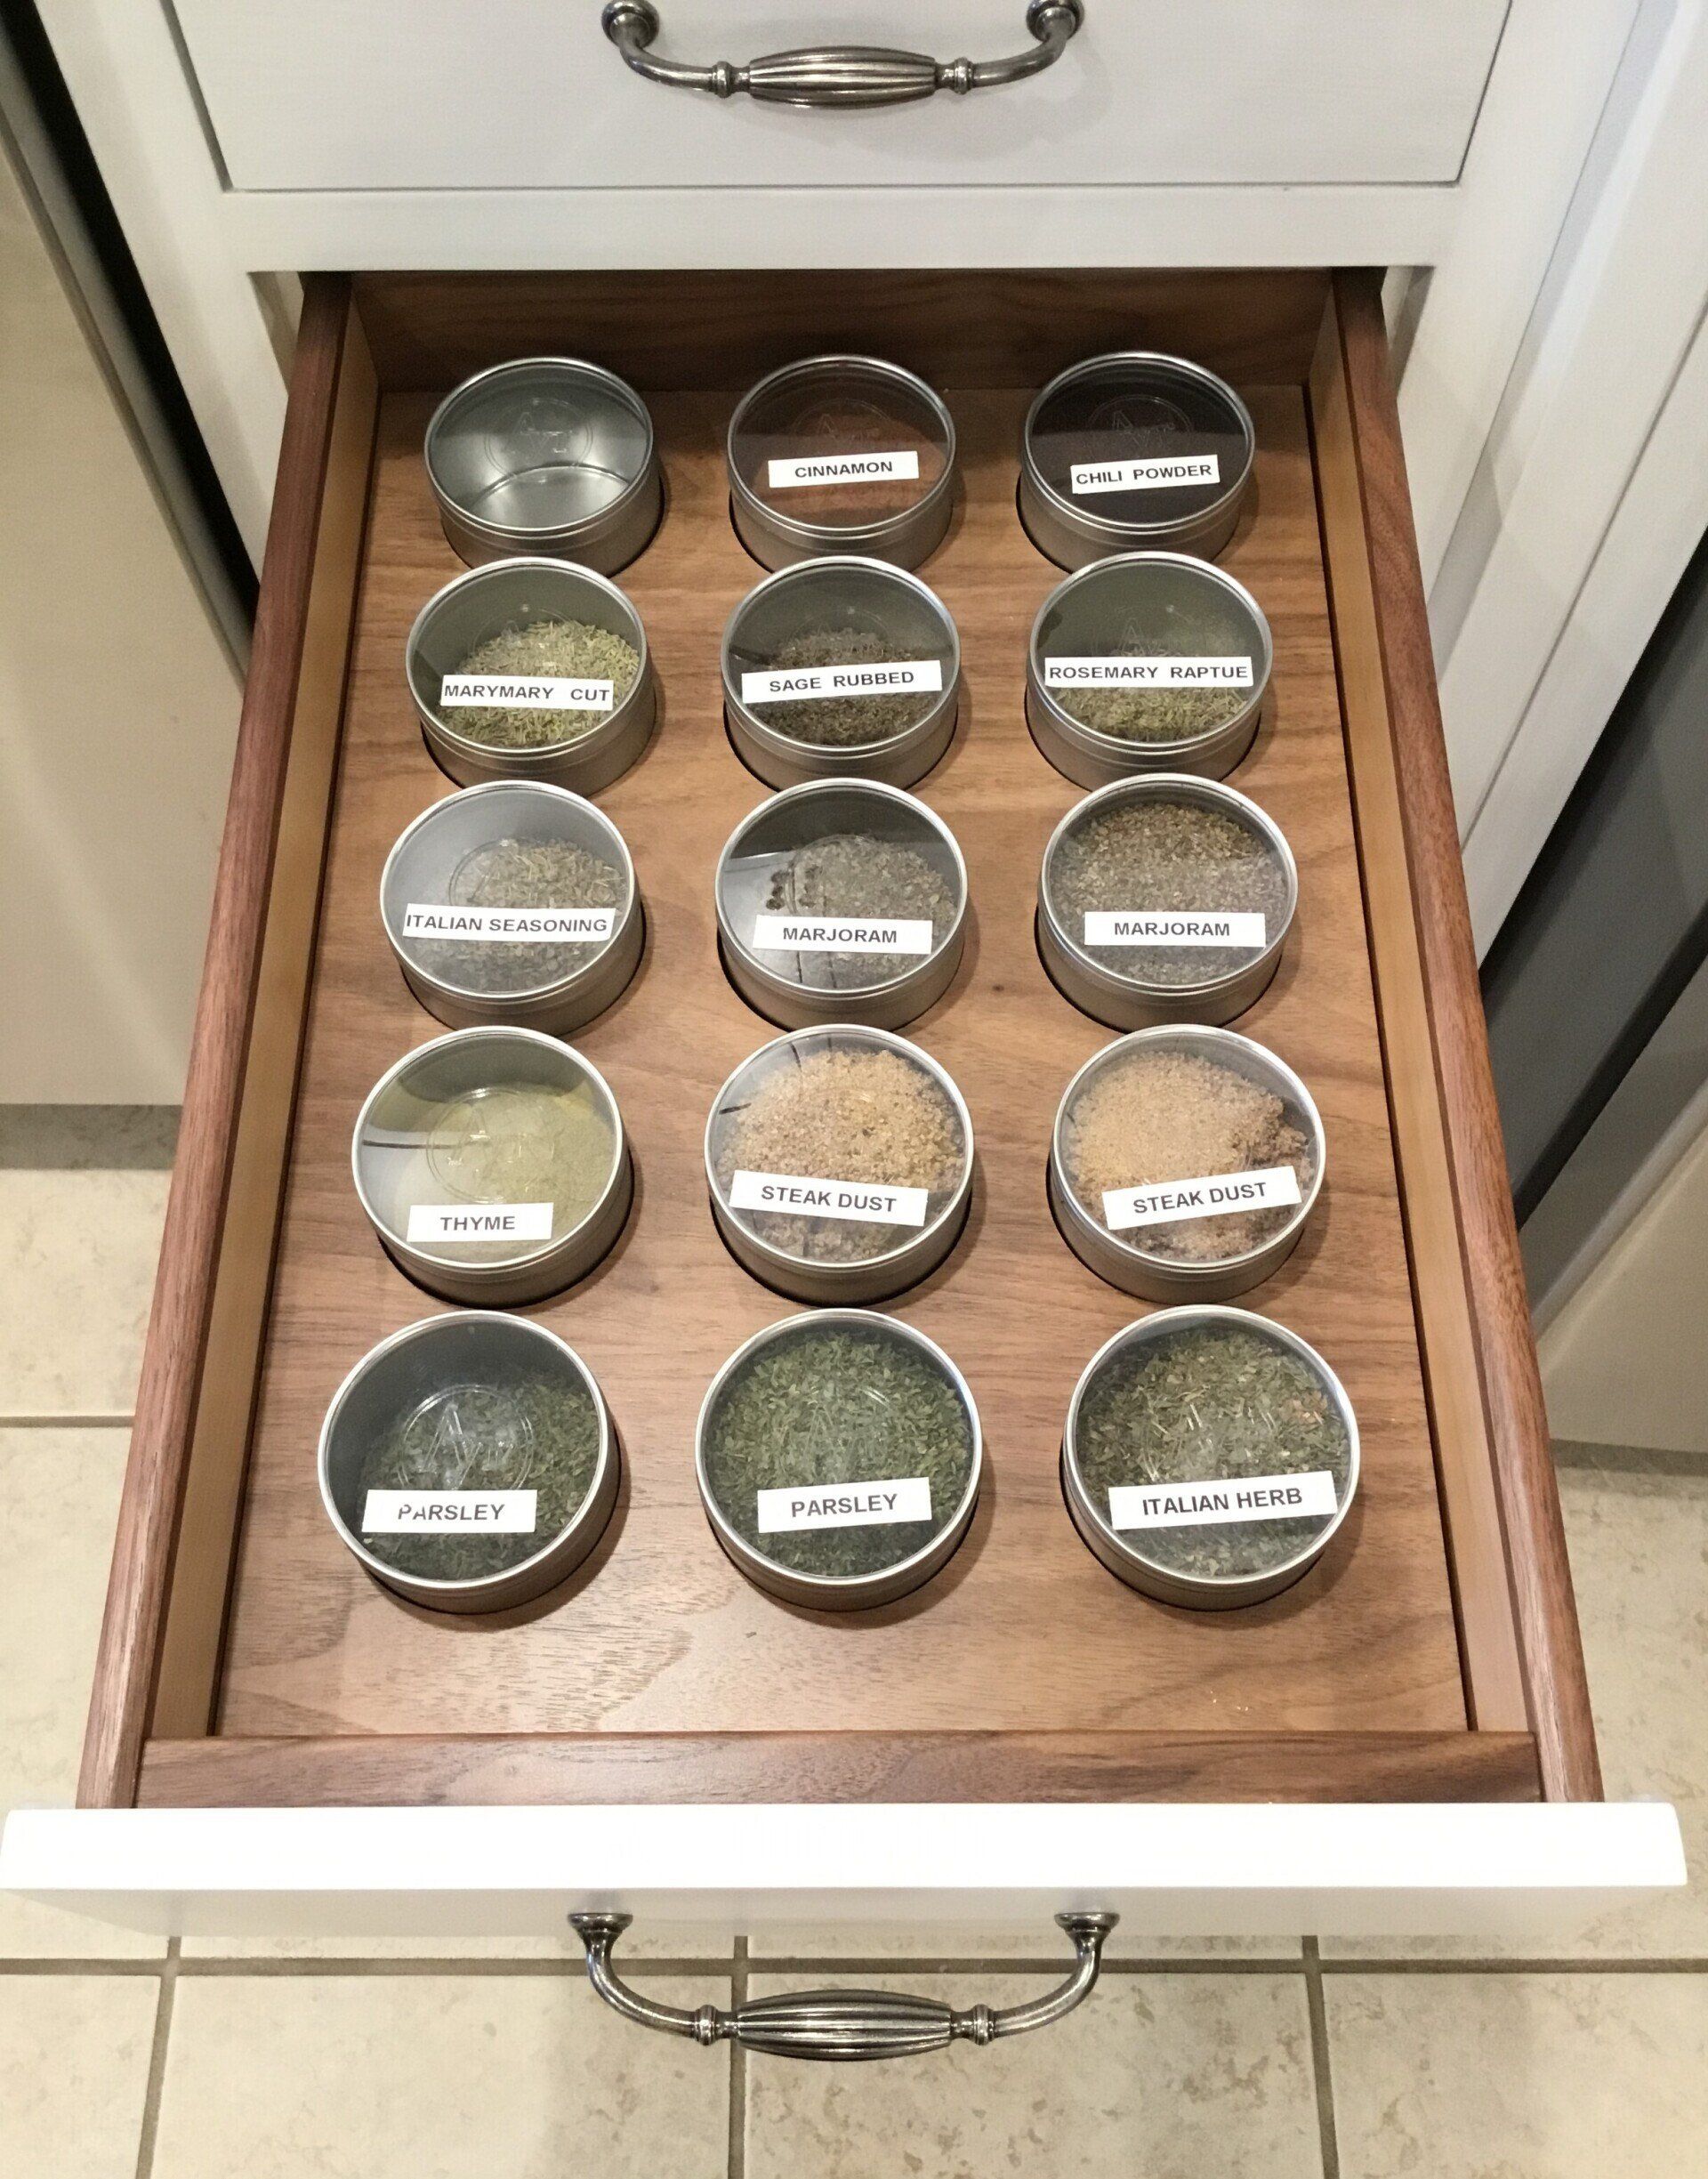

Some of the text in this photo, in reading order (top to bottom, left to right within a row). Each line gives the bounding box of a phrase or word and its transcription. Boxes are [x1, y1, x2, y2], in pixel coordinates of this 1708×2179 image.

[794, 461, 893, 479] CINNAMON
[1076, 464, 1213, 485] CHILI POWDER
[769, 671, 914, 692] SAGE RUBBED
[1049, 666, 1248, 679] ROSEMARY RAPTUE
[444, 684, 610, 702] MARYMARY CUT
[407, 914, 607, 932] ITALIAN SEASONING
[1114, 922, 1230, 937] MARJORAM
[783, 927, 897, 943] MARJORAM
[761, 1185, 898, 1213] STEAK DUST
[1132, 1182, 1267, 1214] STEAK DUST
[439, 1215, 515, 1231] THYME
[791, 1493, 898, 1518] PARSLEY
[1142, 1487, 1303, 1516] ITALIAN HERB
[398, 1504, 505, 1521] PARSLEY
